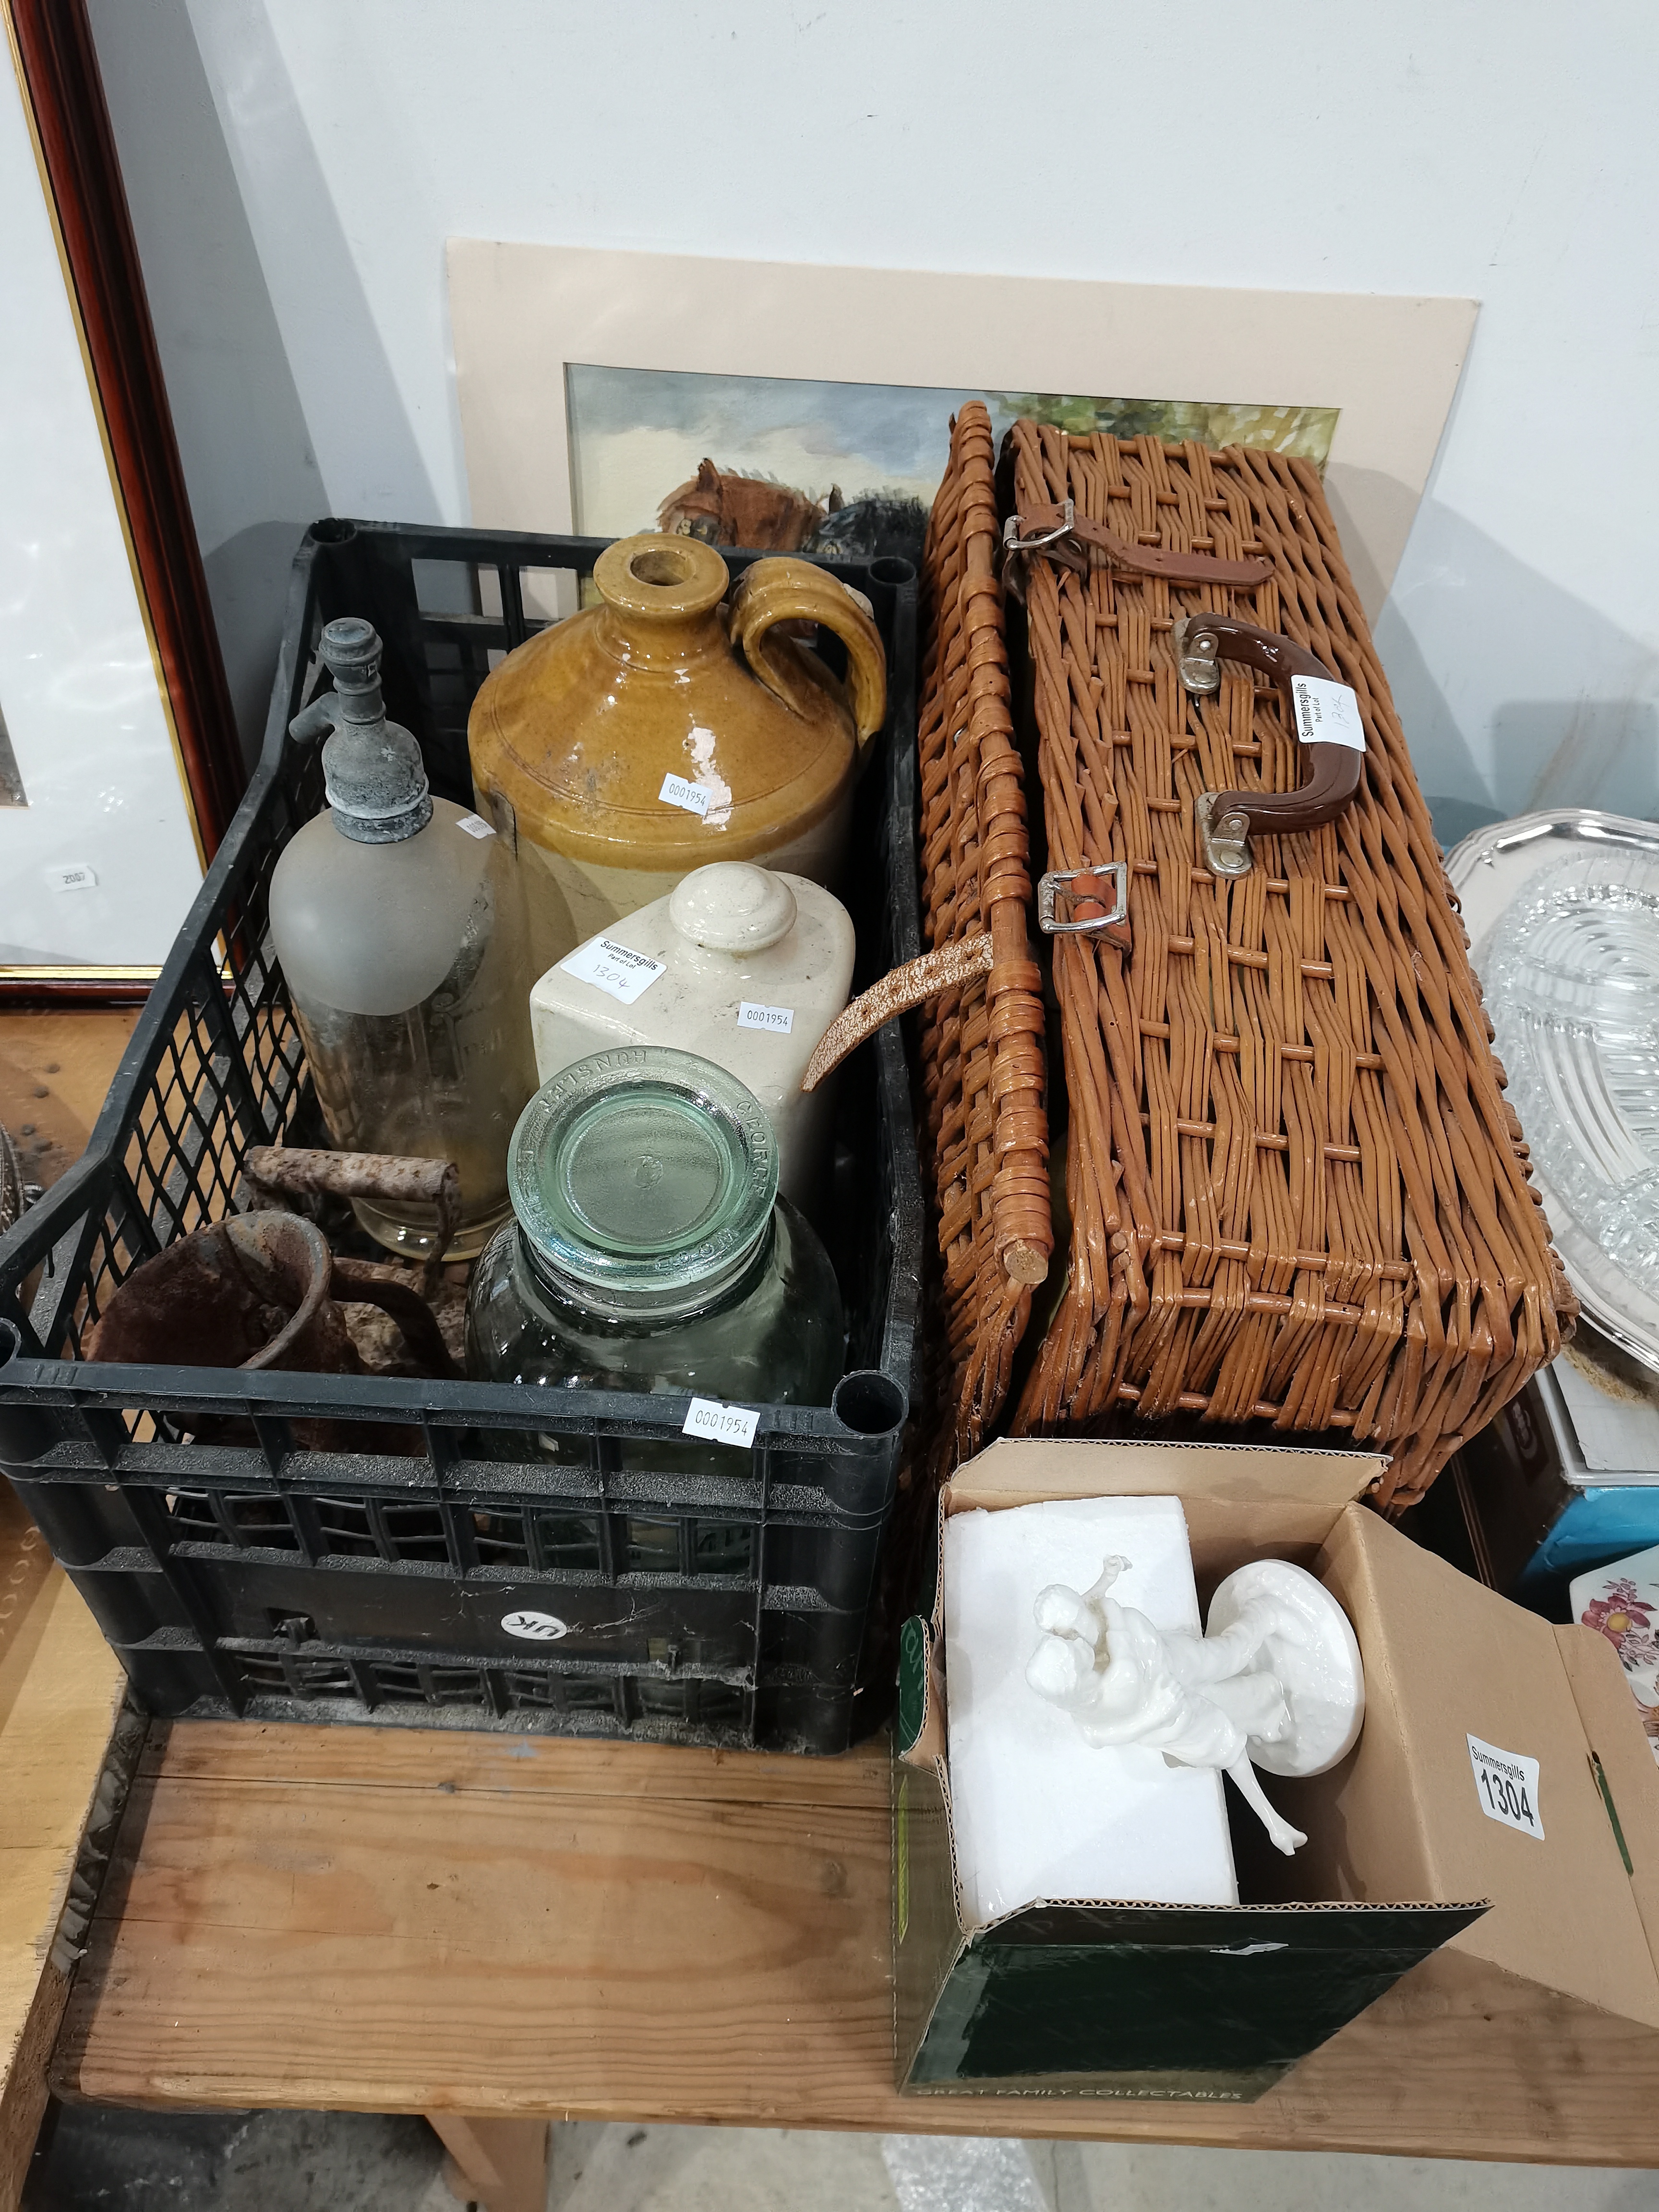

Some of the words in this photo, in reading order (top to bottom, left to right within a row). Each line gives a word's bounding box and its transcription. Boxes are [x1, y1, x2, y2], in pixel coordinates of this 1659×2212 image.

[1295, 683, 1314, 736] Summersgills
[669, 783, 706, 806] 0001954
[601, 941, 658, 970] Summersgills
[608, 953, 620, 962] Part
[593, 964, 630, 989] 1304
[747, 1010, 788, 1026] 0001954
[736, 1100, 769, 1198] GEORGE
[696, 1410, 748, 1436] 0001954
[506, 1615, 561, 1636] UK
[1472, 1745, 1525, 1781] Summersgills
[1481, 1768, 1535, 1827] 1304
[1079, 2089, 1242, 2099] COLLECTABLES
